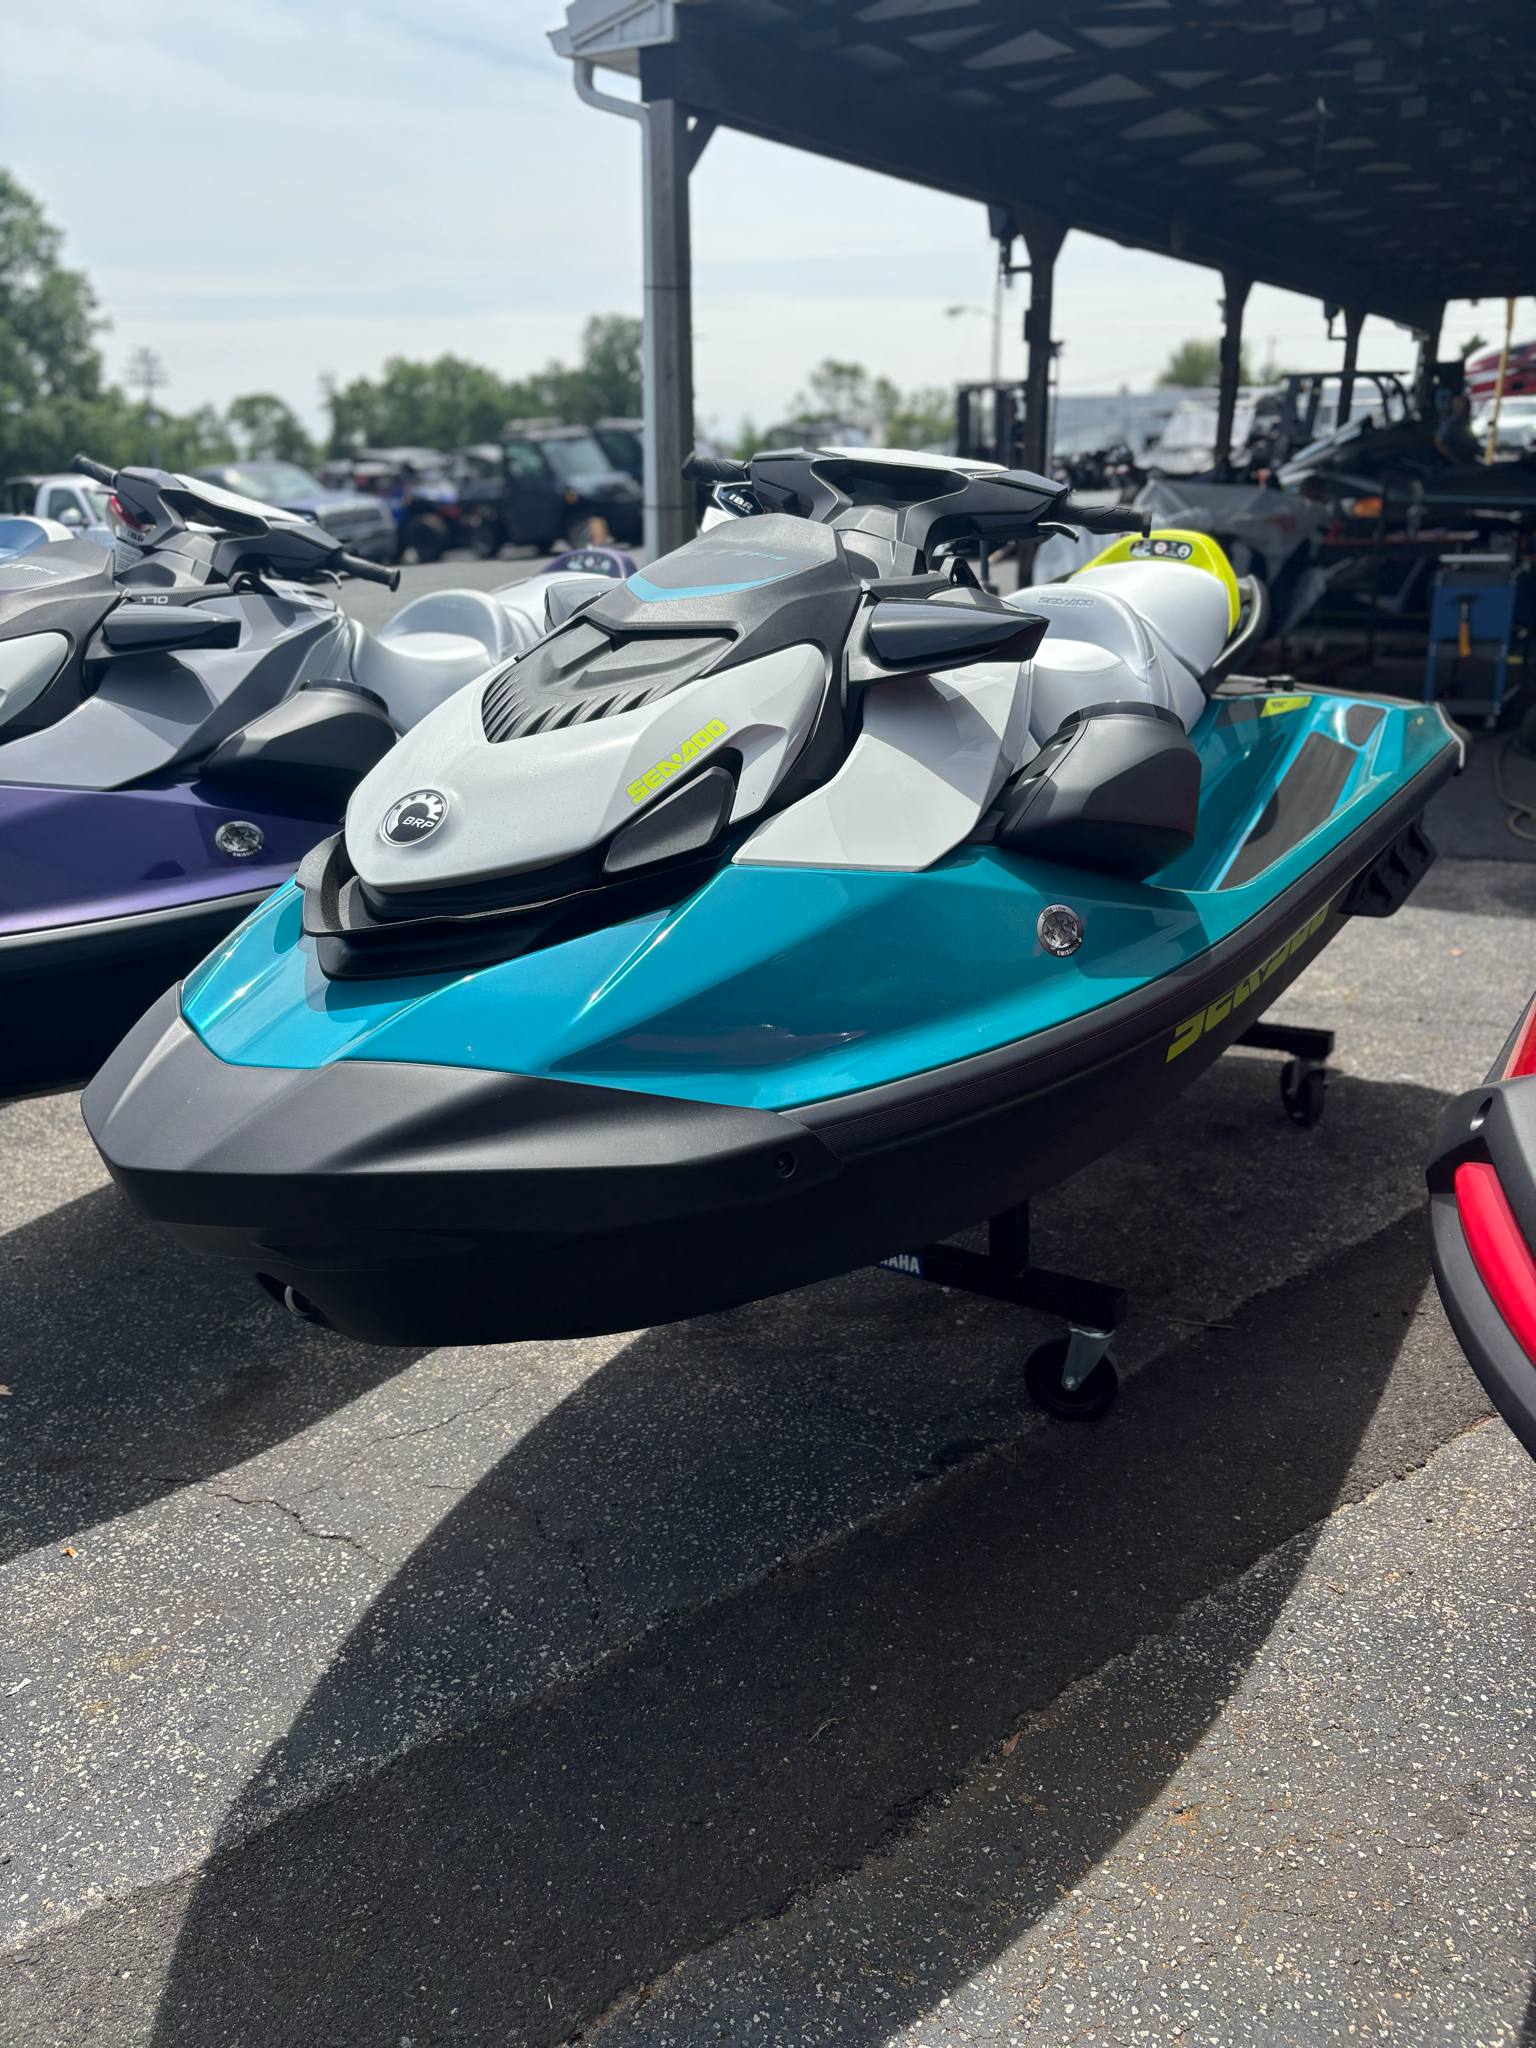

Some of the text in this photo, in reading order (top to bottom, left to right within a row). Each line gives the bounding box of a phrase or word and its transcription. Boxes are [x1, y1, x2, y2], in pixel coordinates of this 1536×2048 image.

[729, 493, 754, 511] IBR
[141, 595, 169, 605] 170
[402, 815, 435, 829] BRP
